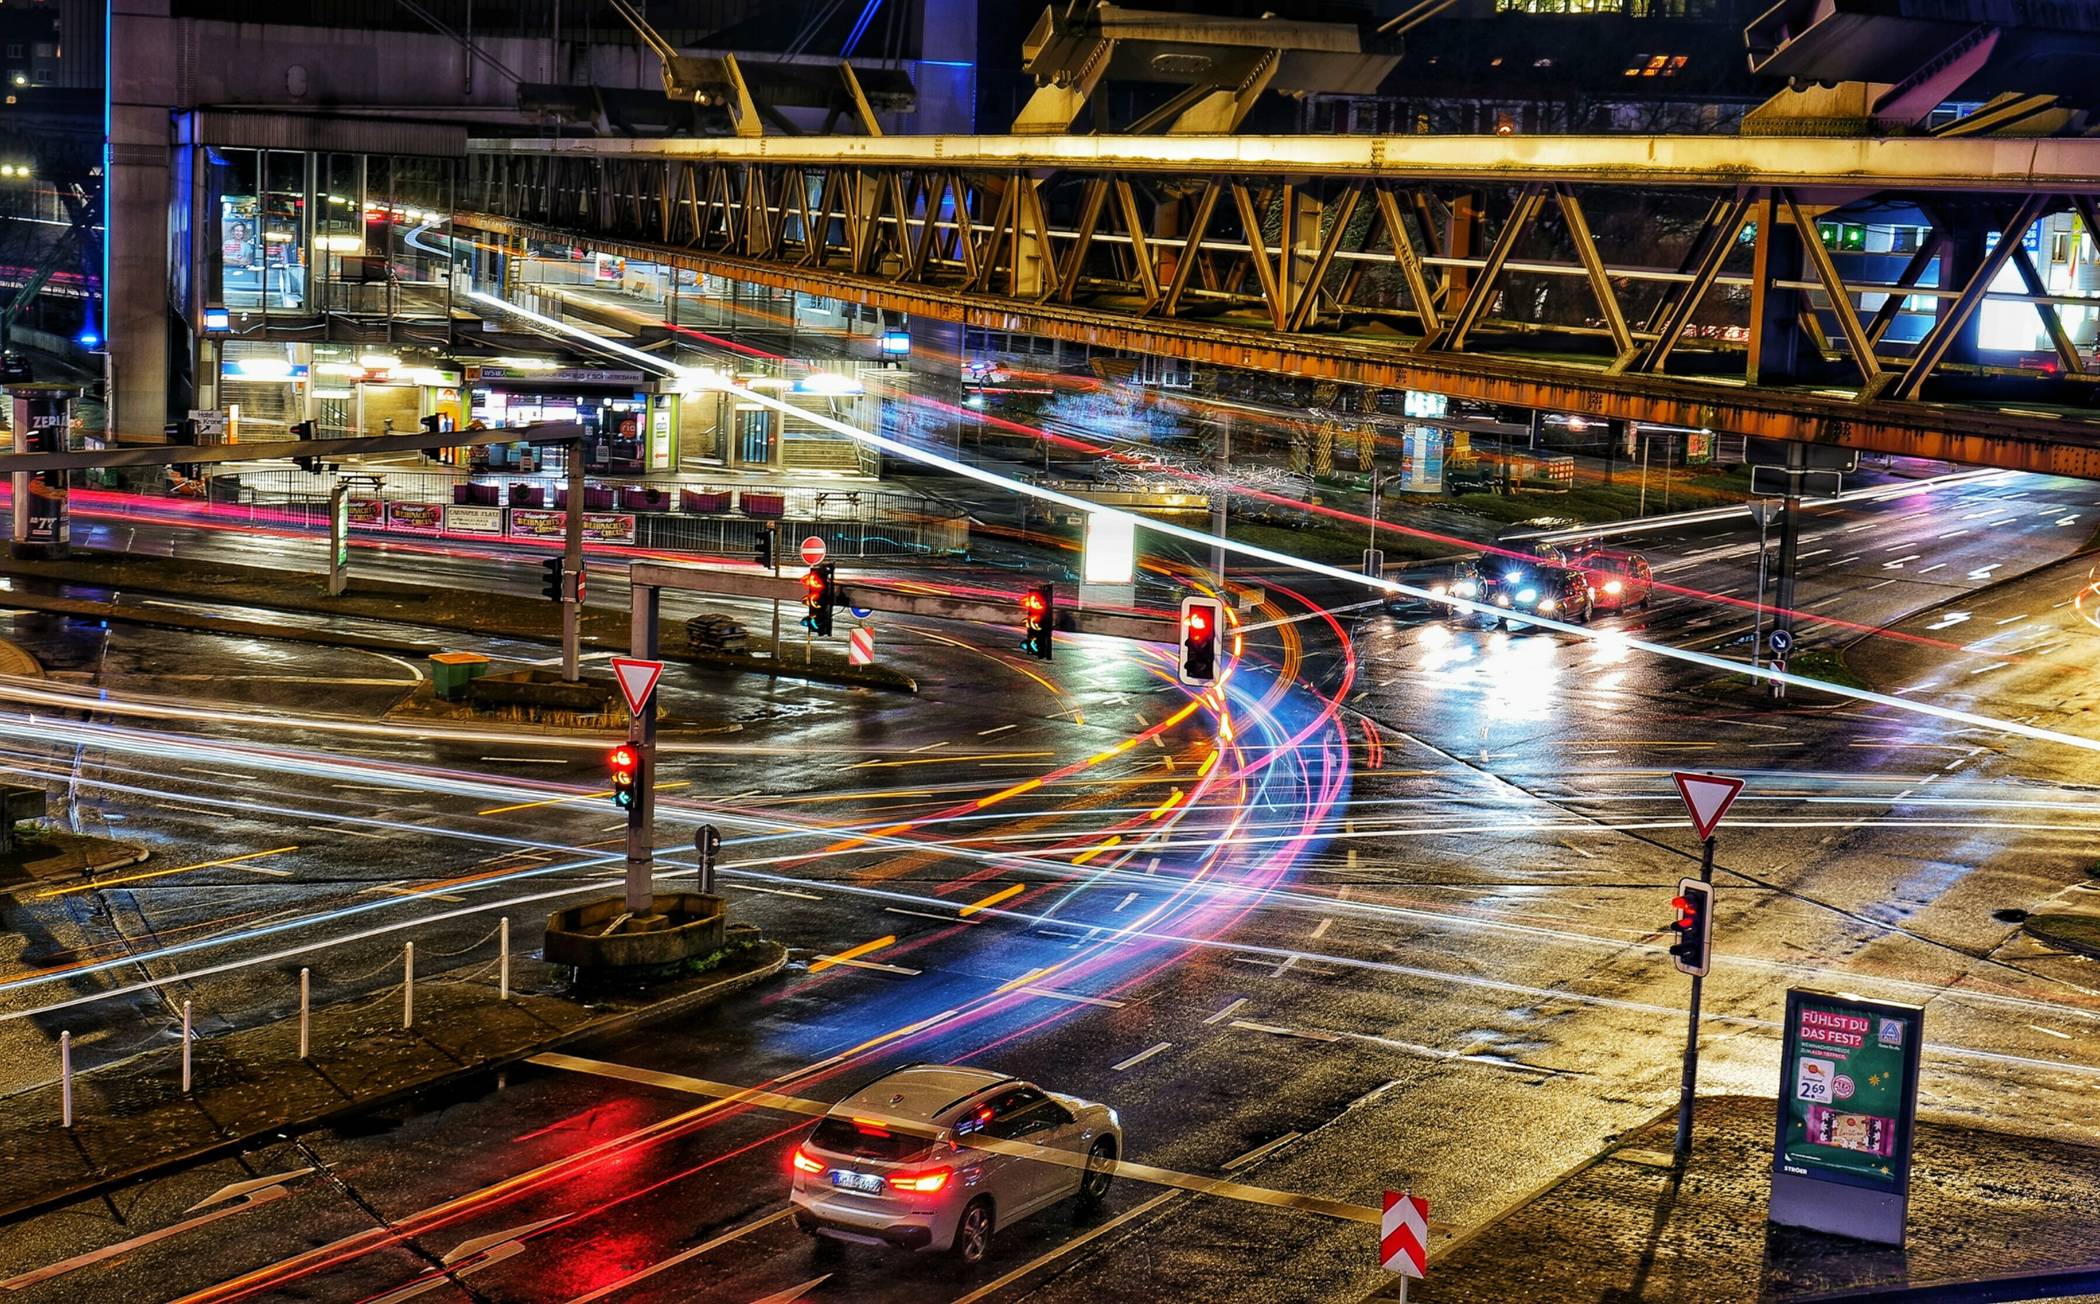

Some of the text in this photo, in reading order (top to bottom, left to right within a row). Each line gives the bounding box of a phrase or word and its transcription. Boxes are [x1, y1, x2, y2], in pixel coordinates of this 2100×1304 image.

[1802, 1011, 1868, 1032] FÜHLST DU
[1801, 1027, 1862, 1046] DAS FEST?
[1800, 1082, 1825, 1098] 2.69
[1784, 1165, 1808, 1175] STRÖER
